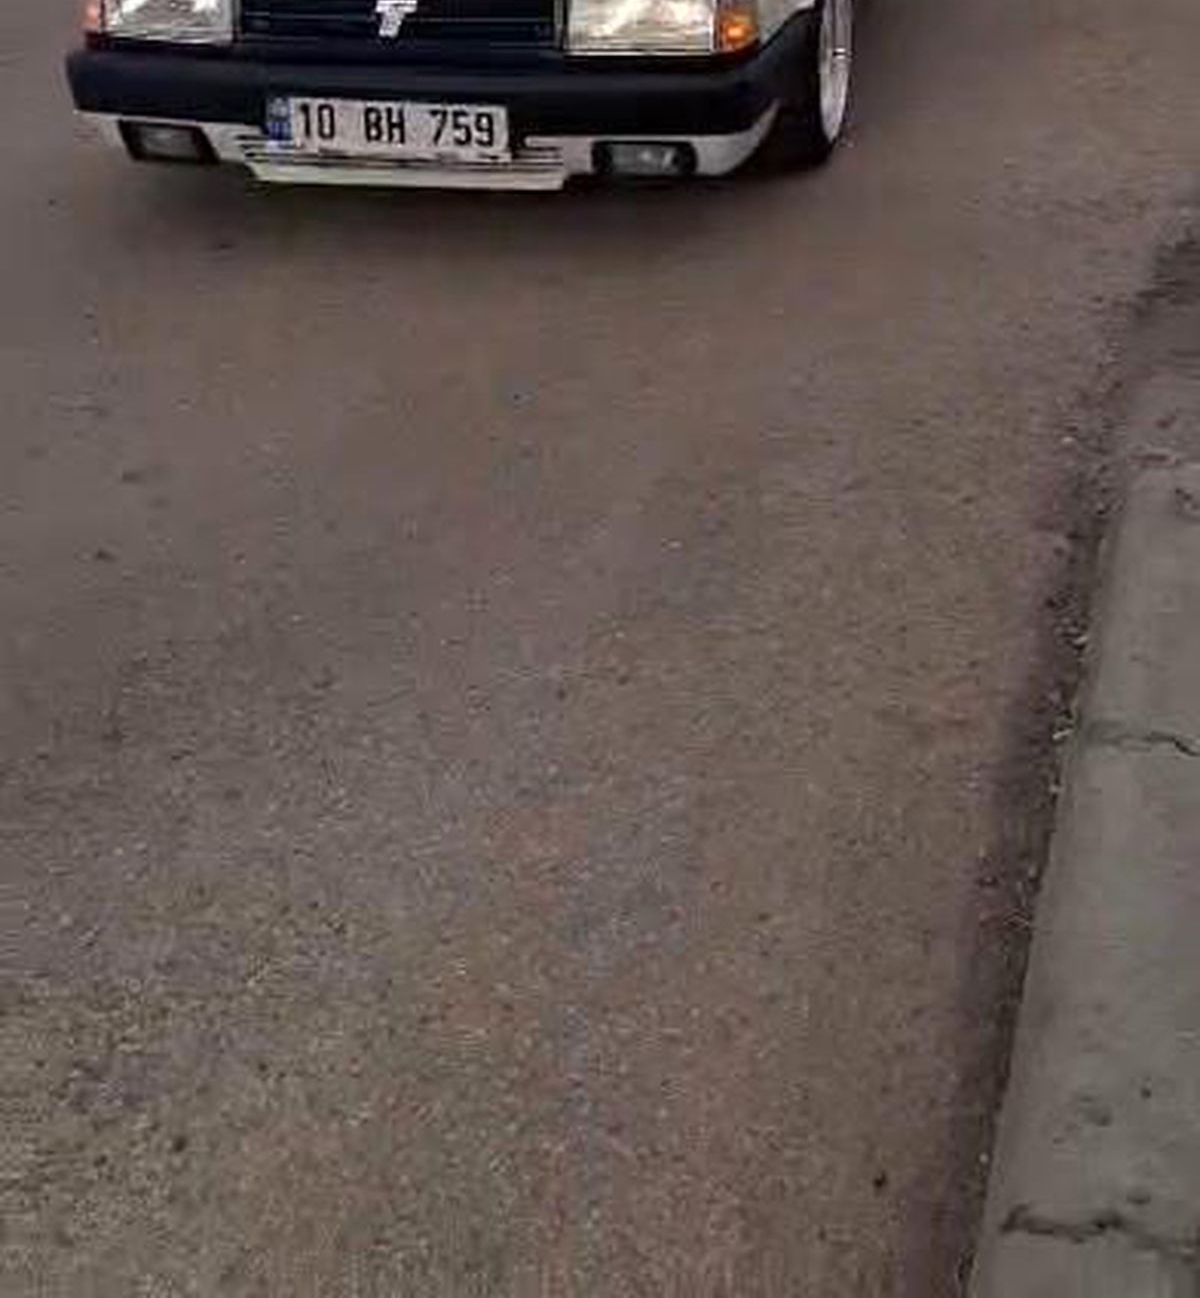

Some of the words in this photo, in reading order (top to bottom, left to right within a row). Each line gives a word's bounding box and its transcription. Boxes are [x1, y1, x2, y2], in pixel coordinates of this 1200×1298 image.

[300, 103, 335, 139] 10
[363, 106, 405, 144] BH
[430, 108, 495, 147] 759
